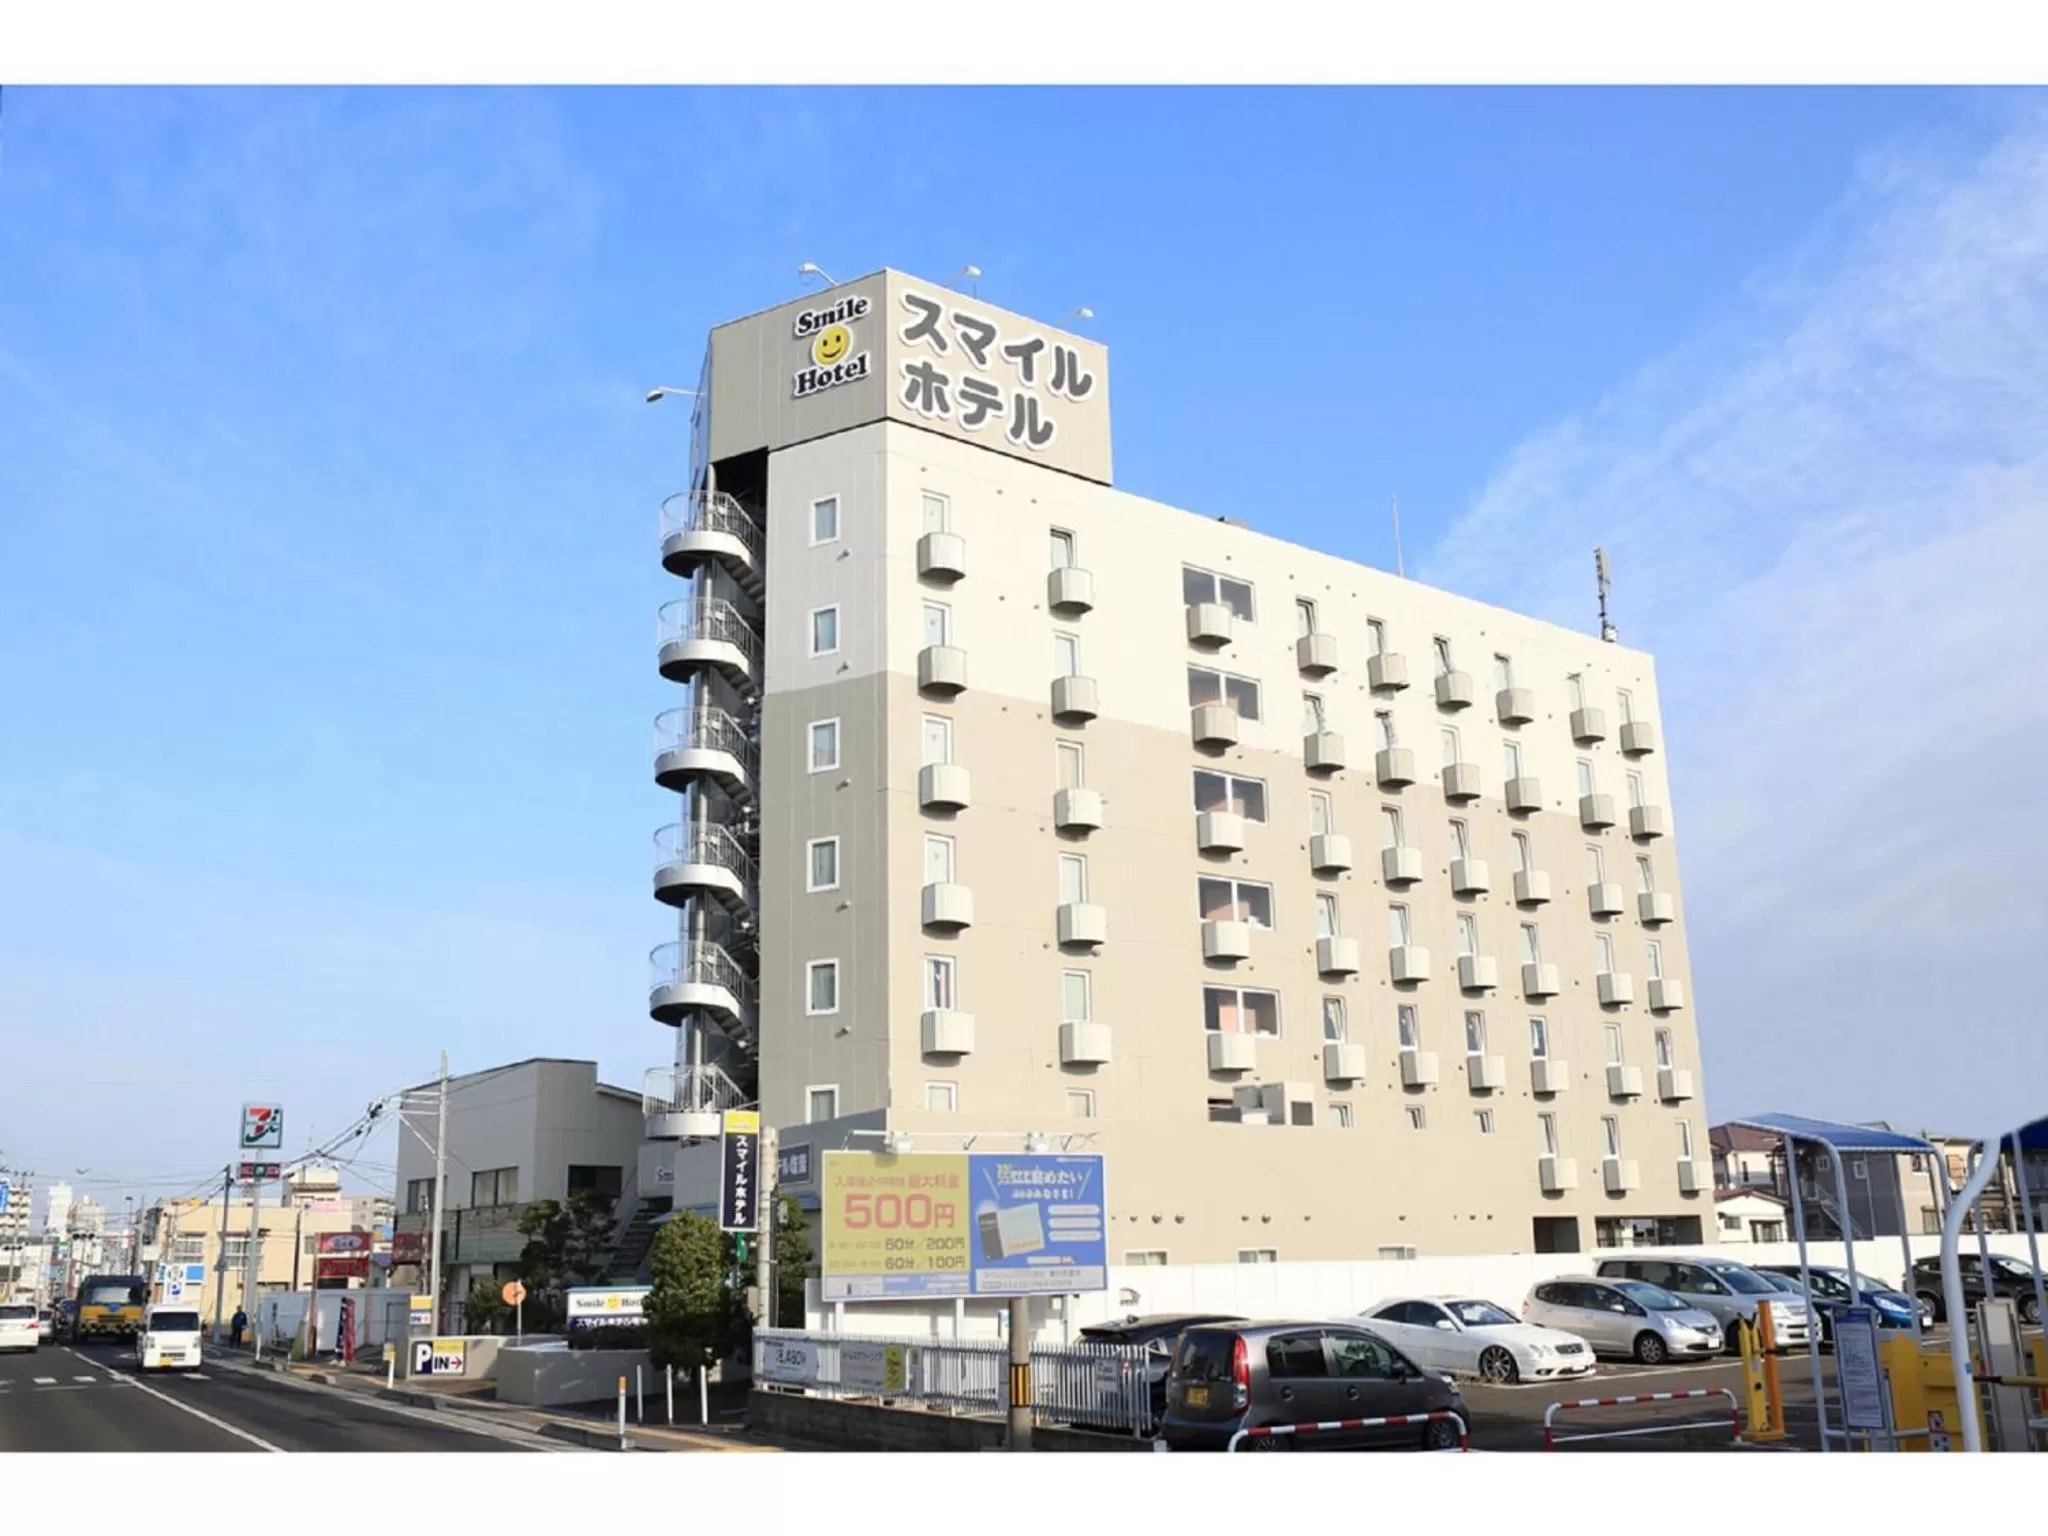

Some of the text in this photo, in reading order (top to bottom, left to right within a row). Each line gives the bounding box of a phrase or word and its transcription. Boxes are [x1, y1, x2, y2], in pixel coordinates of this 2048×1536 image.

[797, 296, 869, 335] Smile
[902, 292, 1093, 398] スマイル
[795, 354, 869, 397] Hotel
[902, 361, 1054, 448] ホテル
[733, 1135, 749, 1225] スマイルホテル
[843, 1193, 955, 1229] 500円
[415, 1343, 432, 1372] P
[434, 1356, 450, 1370] IN
